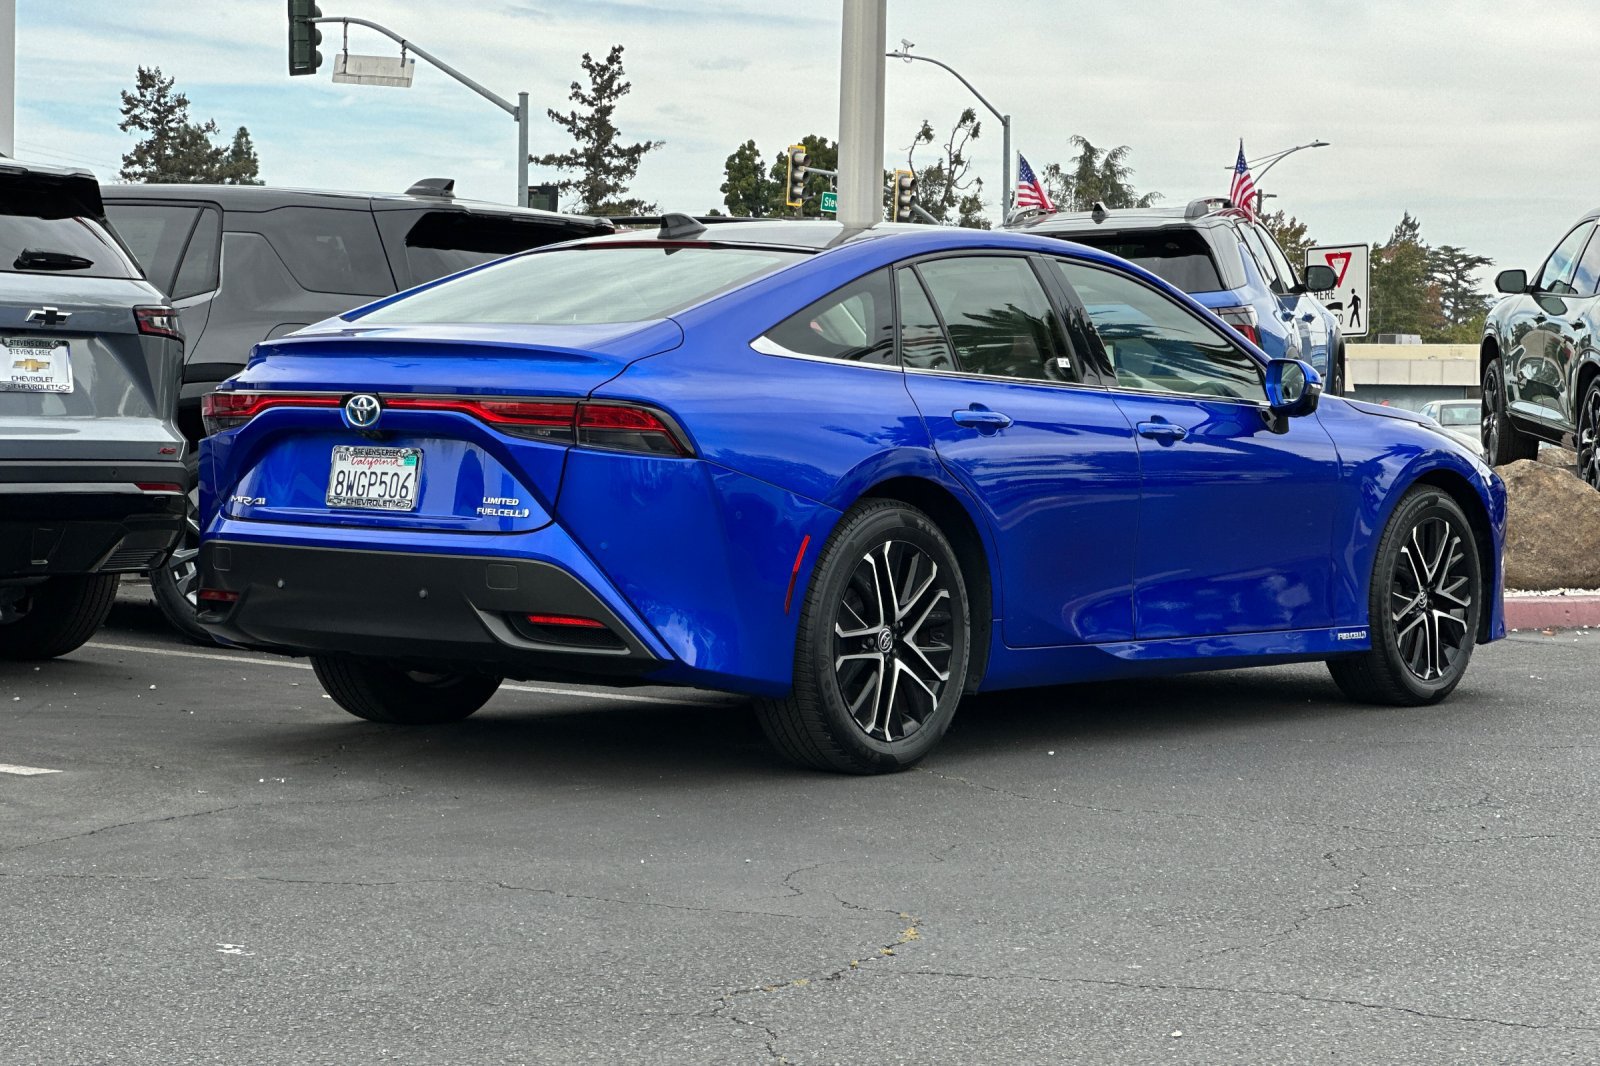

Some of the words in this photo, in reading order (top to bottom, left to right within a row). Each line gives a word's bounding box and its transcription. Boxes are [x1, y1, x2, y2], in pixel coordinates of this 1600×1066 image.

[9, 339, 35, 347] STEVENS
[9, 348, 34, 356] STEVENS
[11, 375, 54, 383] CHEVROLET
[13, 383, 55, 391] CHEVROLET
[353, 448, 381, 456] STEVENS
[351, 456, 403, 470] California
[334, 470, 412, 499] 8WGP506
[345, 497, 393, 507] CHEVROLET
[482, 496, 520, 506] LIMITED
